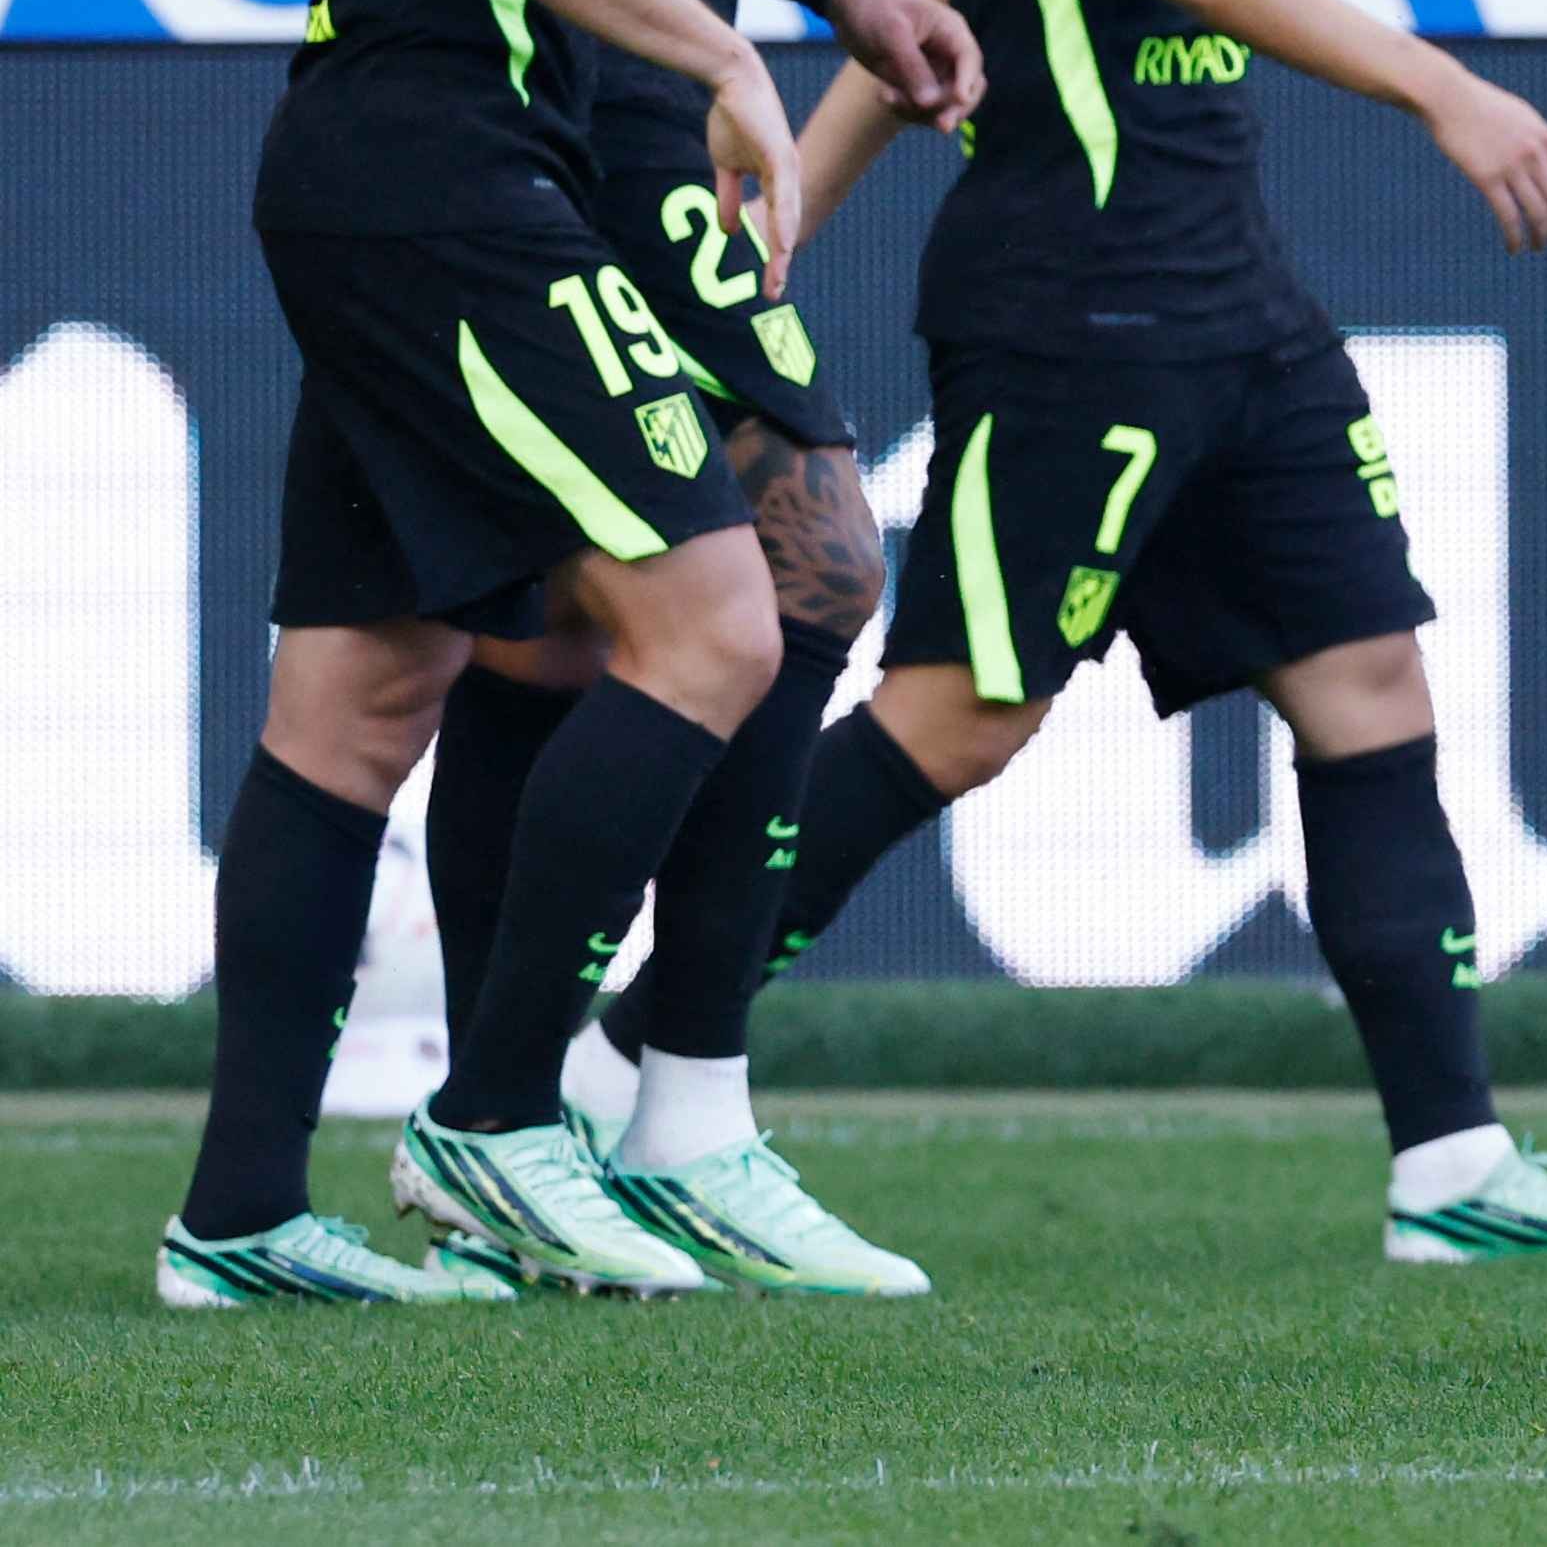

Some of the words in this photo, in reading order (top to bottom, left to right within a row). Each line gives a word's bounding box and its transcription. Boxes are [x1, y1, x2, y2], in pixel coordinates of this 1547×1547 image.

[1134, 35, 1250, 86] RIYAD
[549, 265, 680, 397] 19
[1095, 424, 1157, 554] 7
